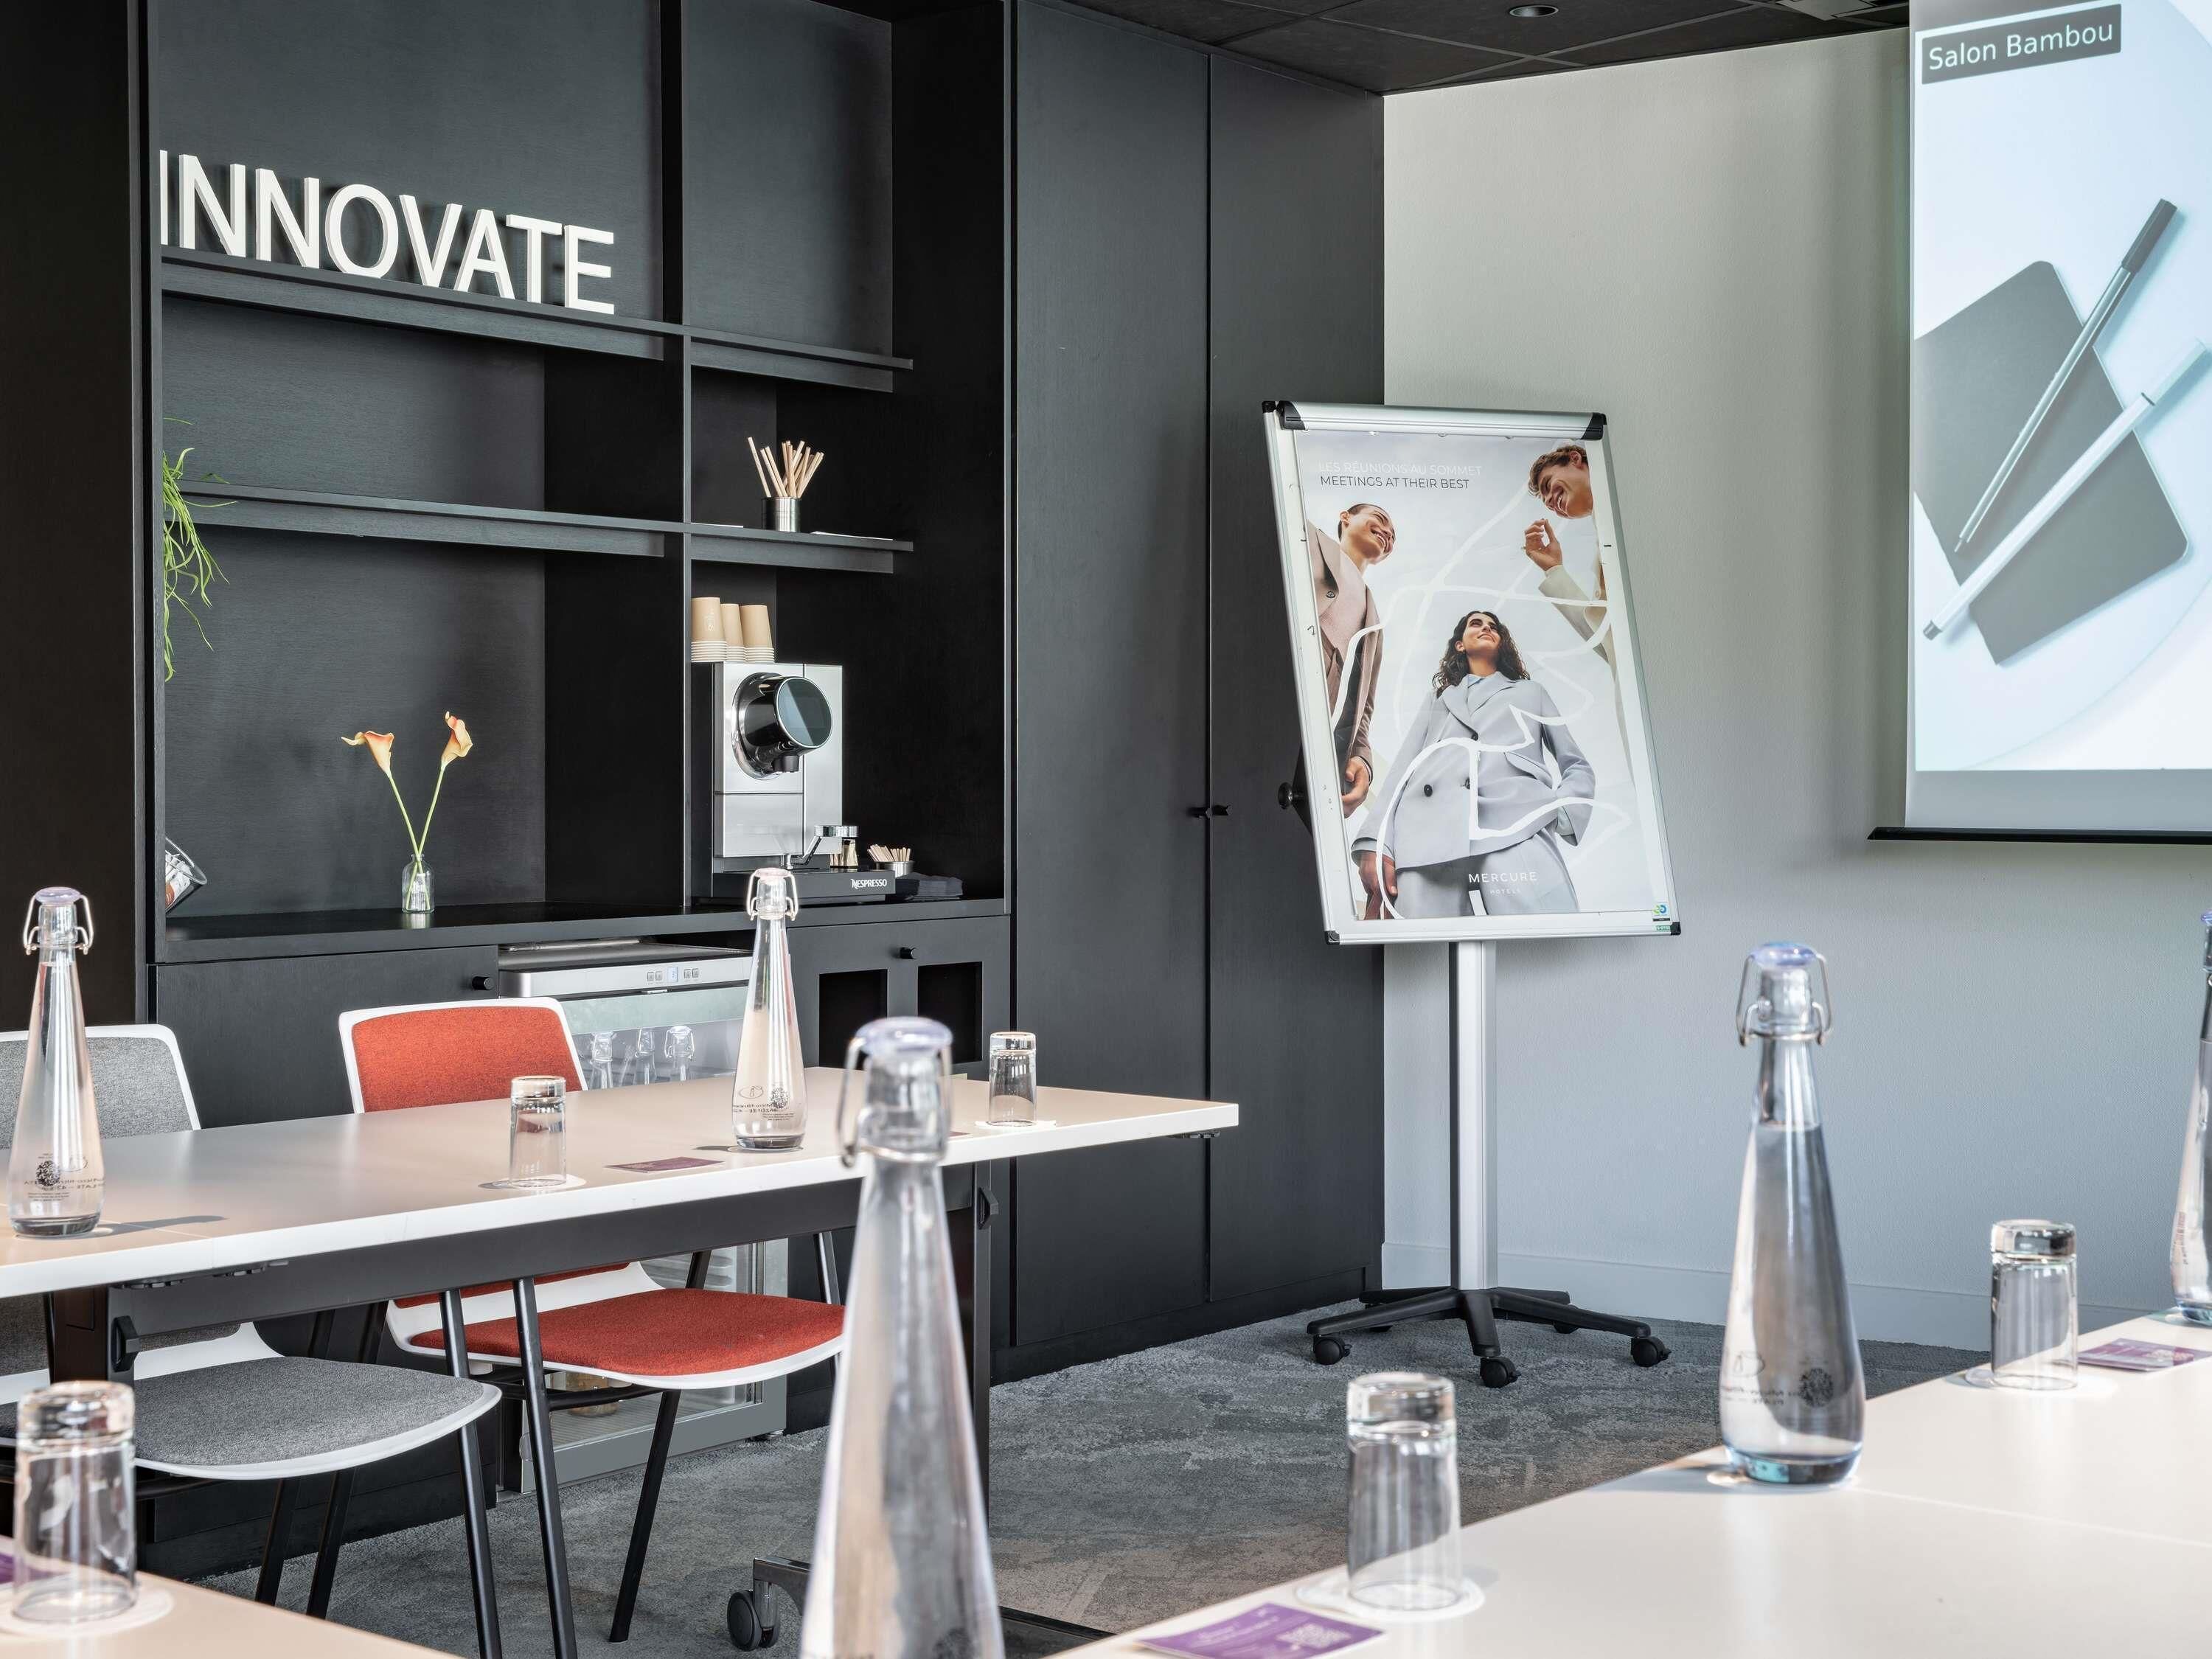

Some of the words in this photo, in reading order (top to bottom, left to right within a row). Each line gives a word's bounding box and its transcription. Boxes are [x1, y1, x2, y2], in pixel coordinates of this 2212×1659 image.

[1928, 42, 1997, 71] Salon
[2006, 24, 2113, 58] Bambou
[159, 149, 615, 315] INNOVATE
[1318, 461, 1340, 472] LES
[1344, 459, 1408, 474] RÉUNIONS
[1411, 462, 1427, 475] AU
[1430, 464, 1481, 477] SOMMET
[1320, 476, 1383, 487] MEETINGS
[1385, 477, 1400, 487] AT
[1401, 478, 1439, 488] THEIR
[1440, 479, 1470, 489] BEST
[850, 878, 887, 889] NESPRESSO
[1468, 871, 1538, 884] MERCURE
[1489, 886, 1522, 896] HOTELS
